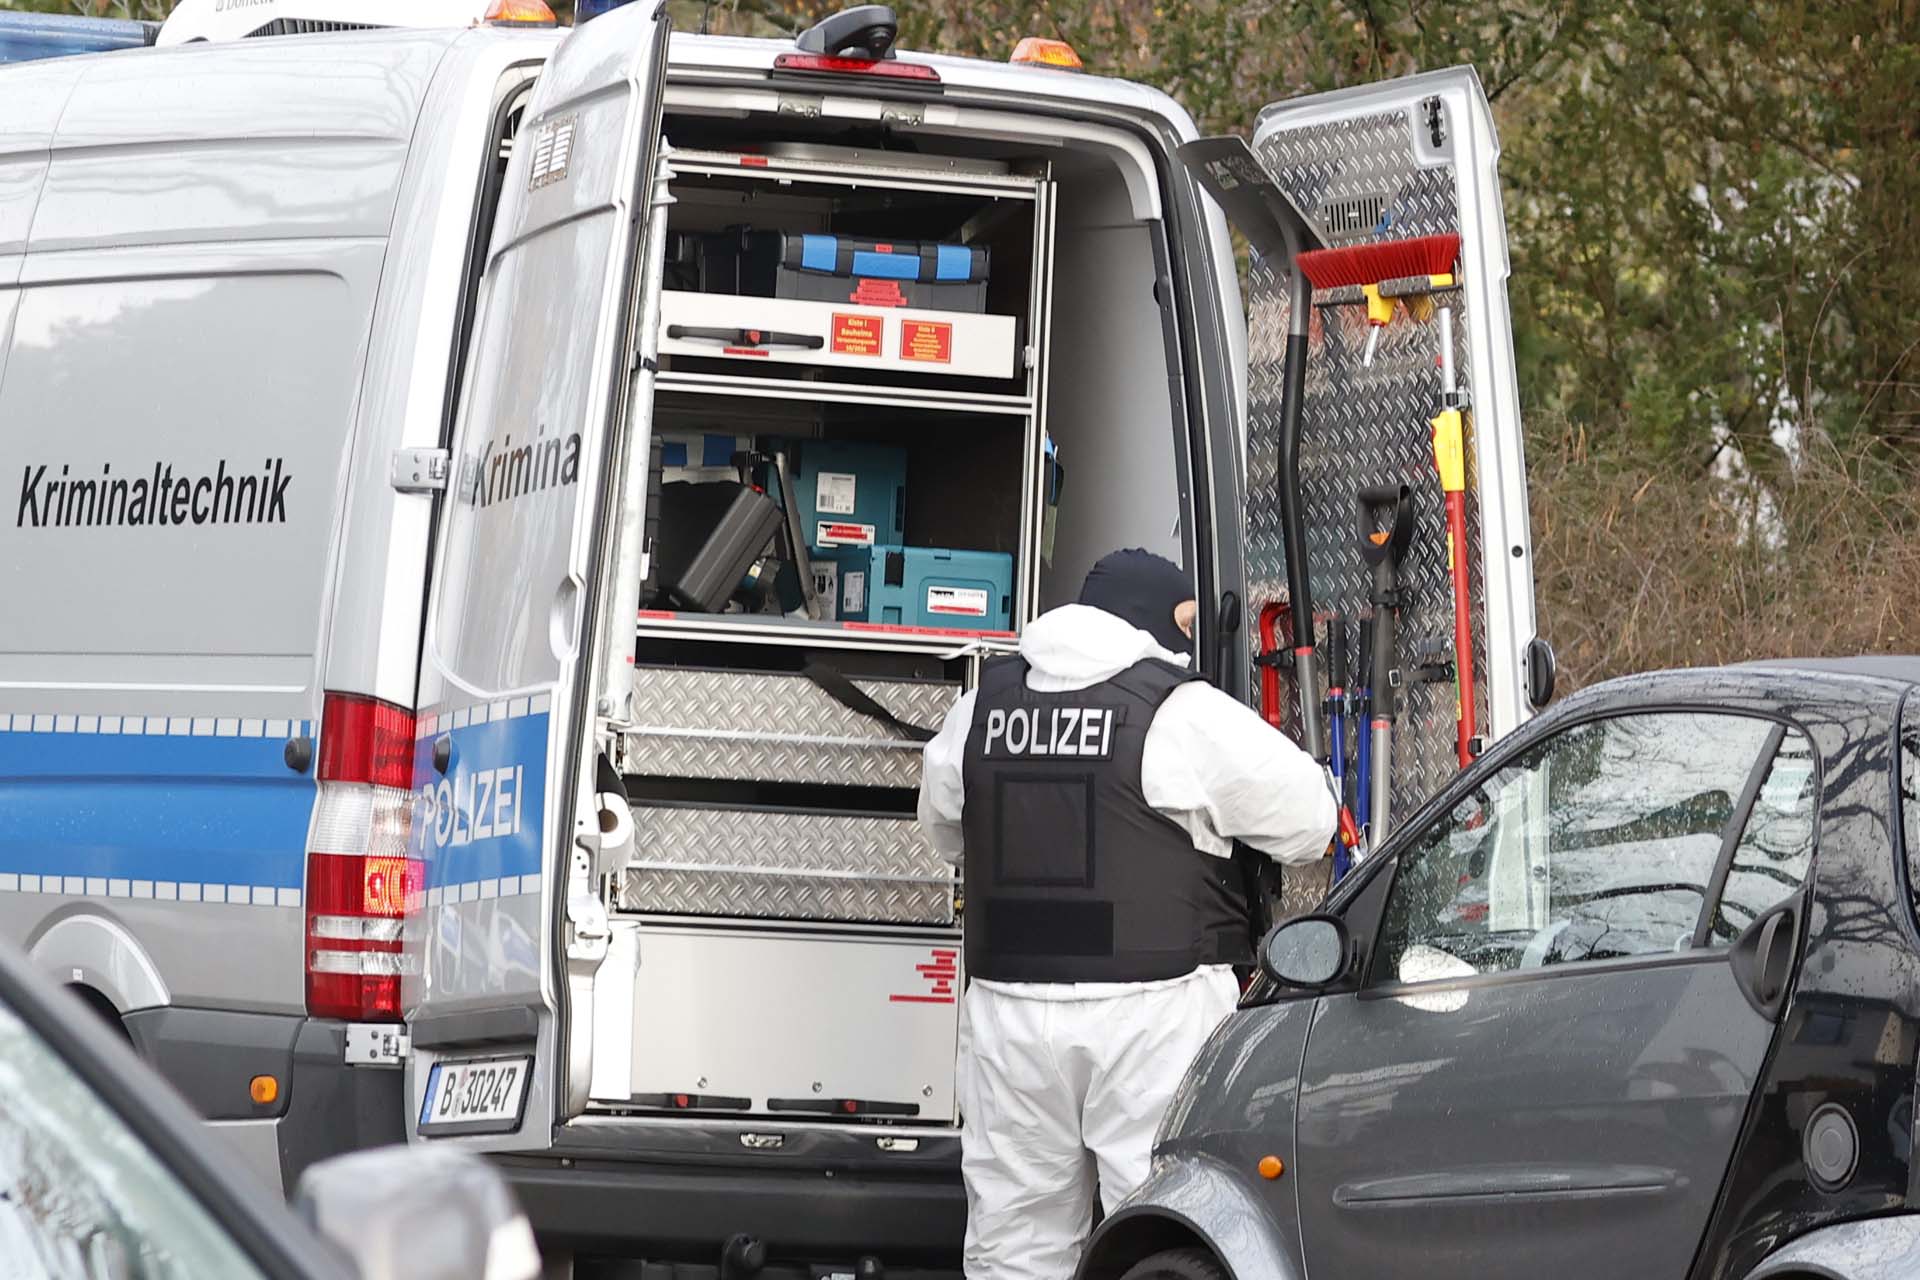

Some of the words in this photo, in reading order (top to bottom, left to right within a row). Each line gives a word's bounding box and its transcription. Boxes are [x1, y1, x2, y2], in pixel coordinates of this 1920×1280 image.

[17, 458, 292, 527] Kriminaltechnik
[471, 424, 581, 508] Krimina
[984, 708, 1113, 756] POLIZEI
[420, 765, 523, 851] POLIZEI
[440, 1071, 457, 1116] B
[461, 1067, 517, 1114] 30247
